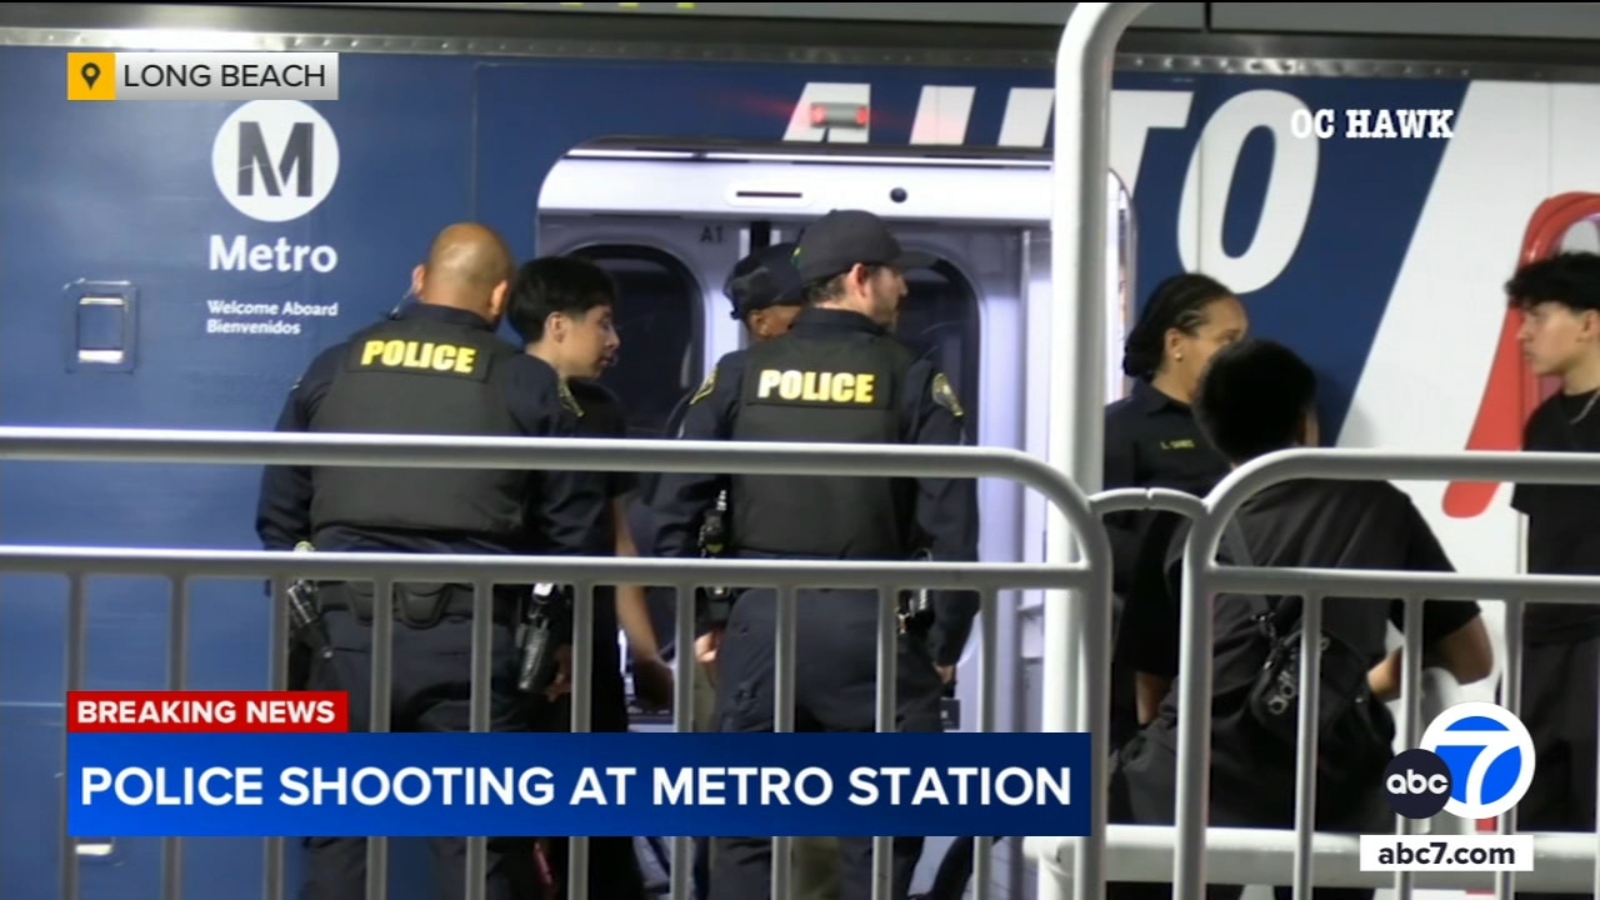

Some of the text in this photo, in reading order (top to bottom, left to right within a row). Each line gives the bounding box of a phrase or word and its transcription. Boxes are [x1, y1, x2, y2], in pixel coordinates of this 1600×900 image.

[237, 121, 314, 197] M
[208, 234, 338, 273] Metro
[206, 299, 339, 317] Welcome Aboard
[206, 319, 301, 335] Bienvenidos
[360, 339, 477, 374] POLICE
[757, 369, 875, 403] POLICE
